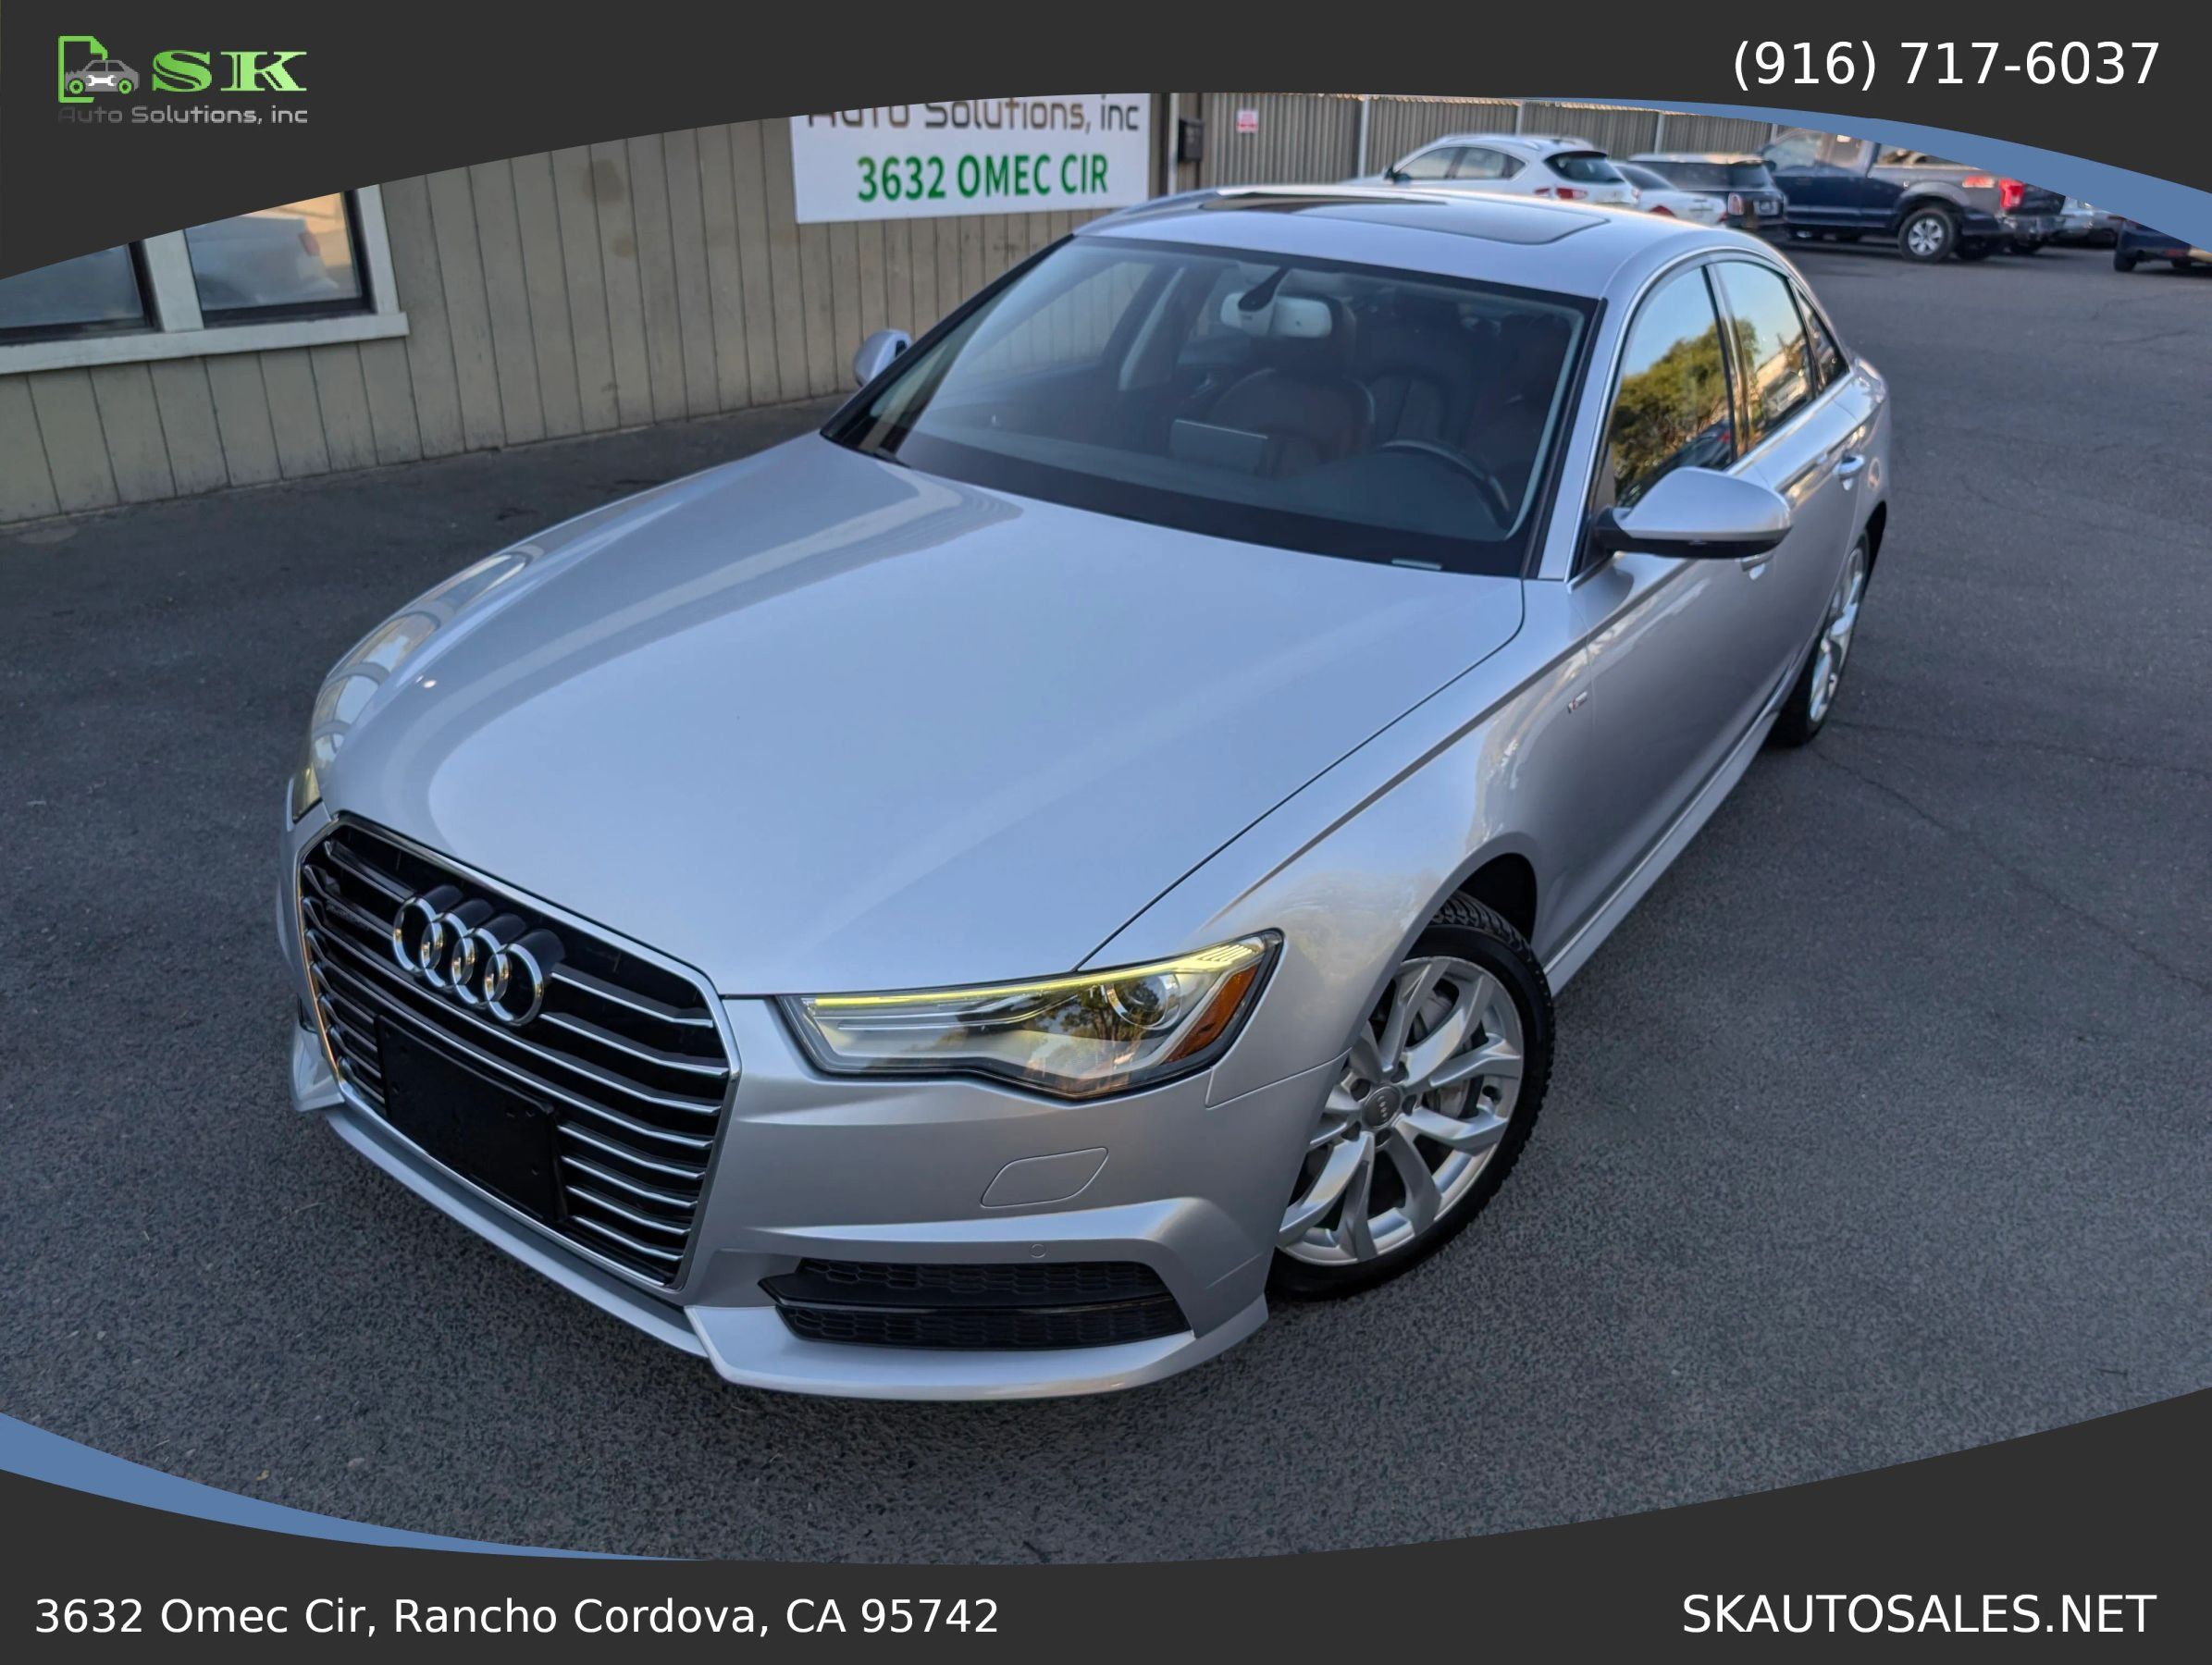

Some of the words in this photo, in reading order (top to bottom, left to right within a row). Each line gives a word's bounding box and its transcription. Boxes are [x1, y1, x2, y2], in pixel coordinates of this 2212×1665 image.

[925, 97, 1092, 135] Solutions,
[1101, 94, 1140, 130] inc
[858, 156, 946, 203] 3632
[958, 154, 1053, 198] OMEC
[1060, 154, 1108, 195] CIR
